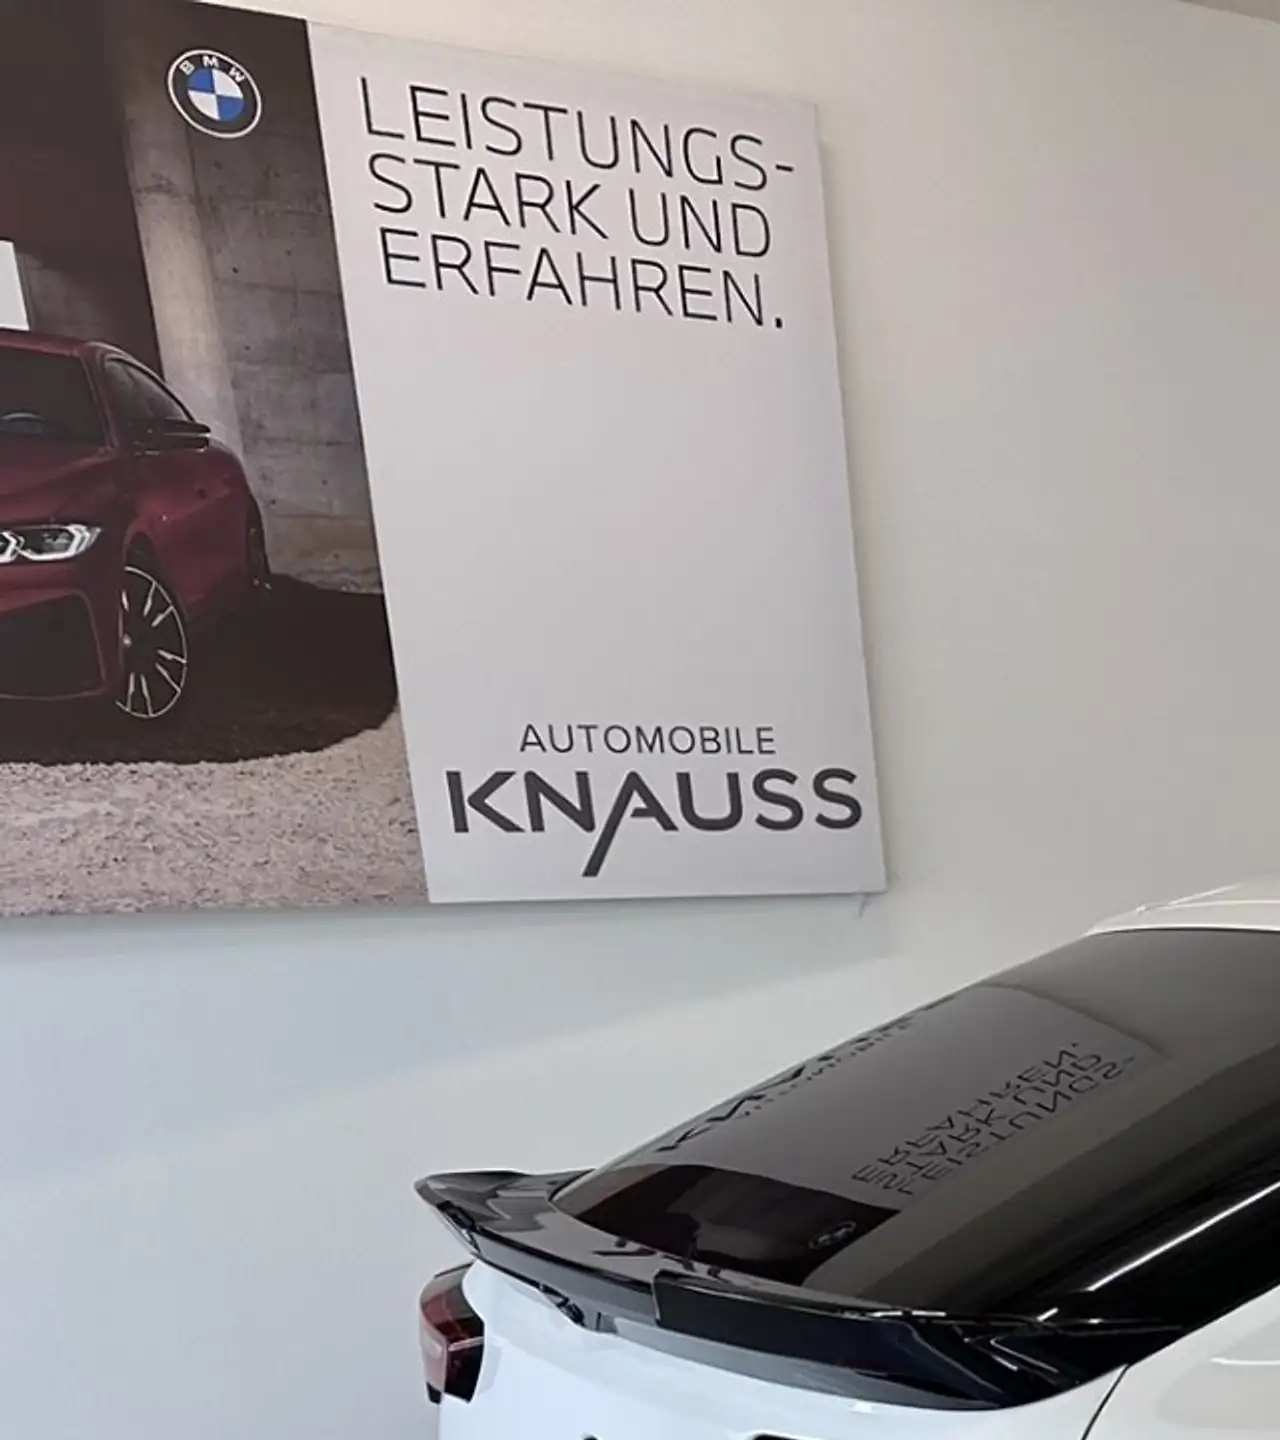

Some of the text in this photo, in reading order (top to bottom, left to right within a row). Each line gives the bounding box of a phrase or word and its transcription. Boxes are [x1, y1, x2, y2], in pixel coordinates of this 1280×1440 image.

[179, 55, 246, 83] BMW
[360, 76, 794, 192] LEISTUNGS-
[368, 153, 771, 258] STARK UND
[379, 226, 783, 329] ERFAHREN.
[519, 723, 777, 755] AUTOMOBILE
[445, 767, 863, 877] KNAUSS
